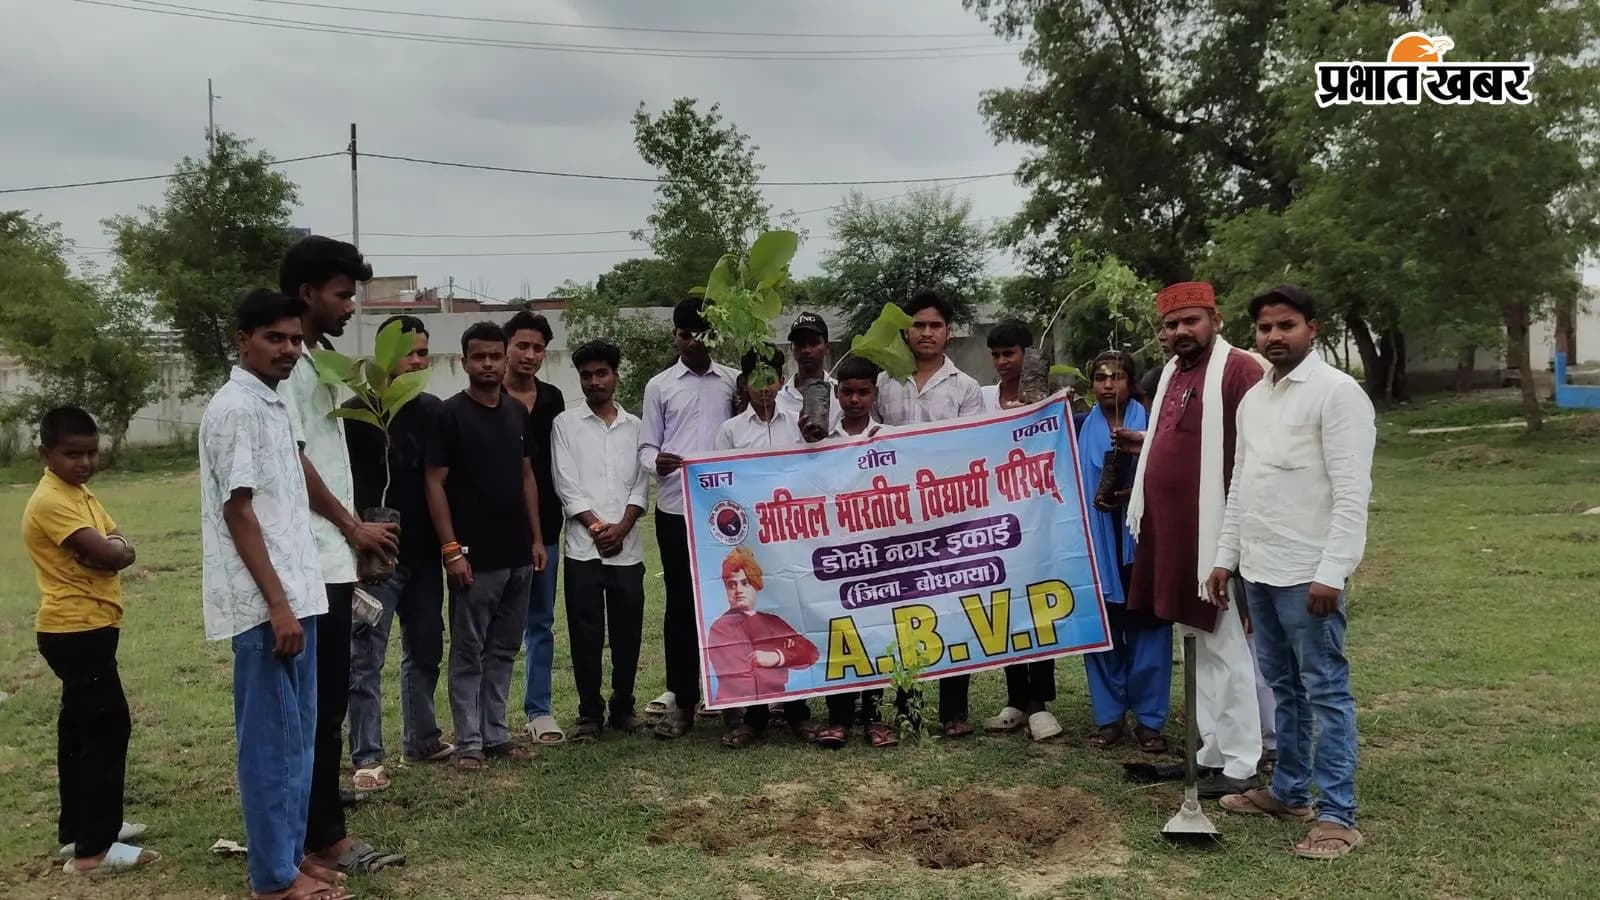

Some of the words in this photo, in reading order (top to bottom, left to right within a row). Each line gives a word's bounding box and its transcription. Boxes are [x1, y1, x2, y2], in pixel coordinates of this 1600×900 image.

[1012, 415, 1059, 442] एकता
[857, 449, 897, 469] शील
[698, 471, 733, 489] ज्ञान
[755, 488, 830, 544] अखिल
[836, 475, 913, 532] भारतीय
[995, 448, 1064, 503] परिषद्
[821, 544, 879, 574] डोभी
[884, 536, 941, 562] नगर
[946, 516, 1011, 555] इकाई
[914, 562, 1000, 592] बोधगया)
[825, 579, 1076, 681] A.B.V.P
